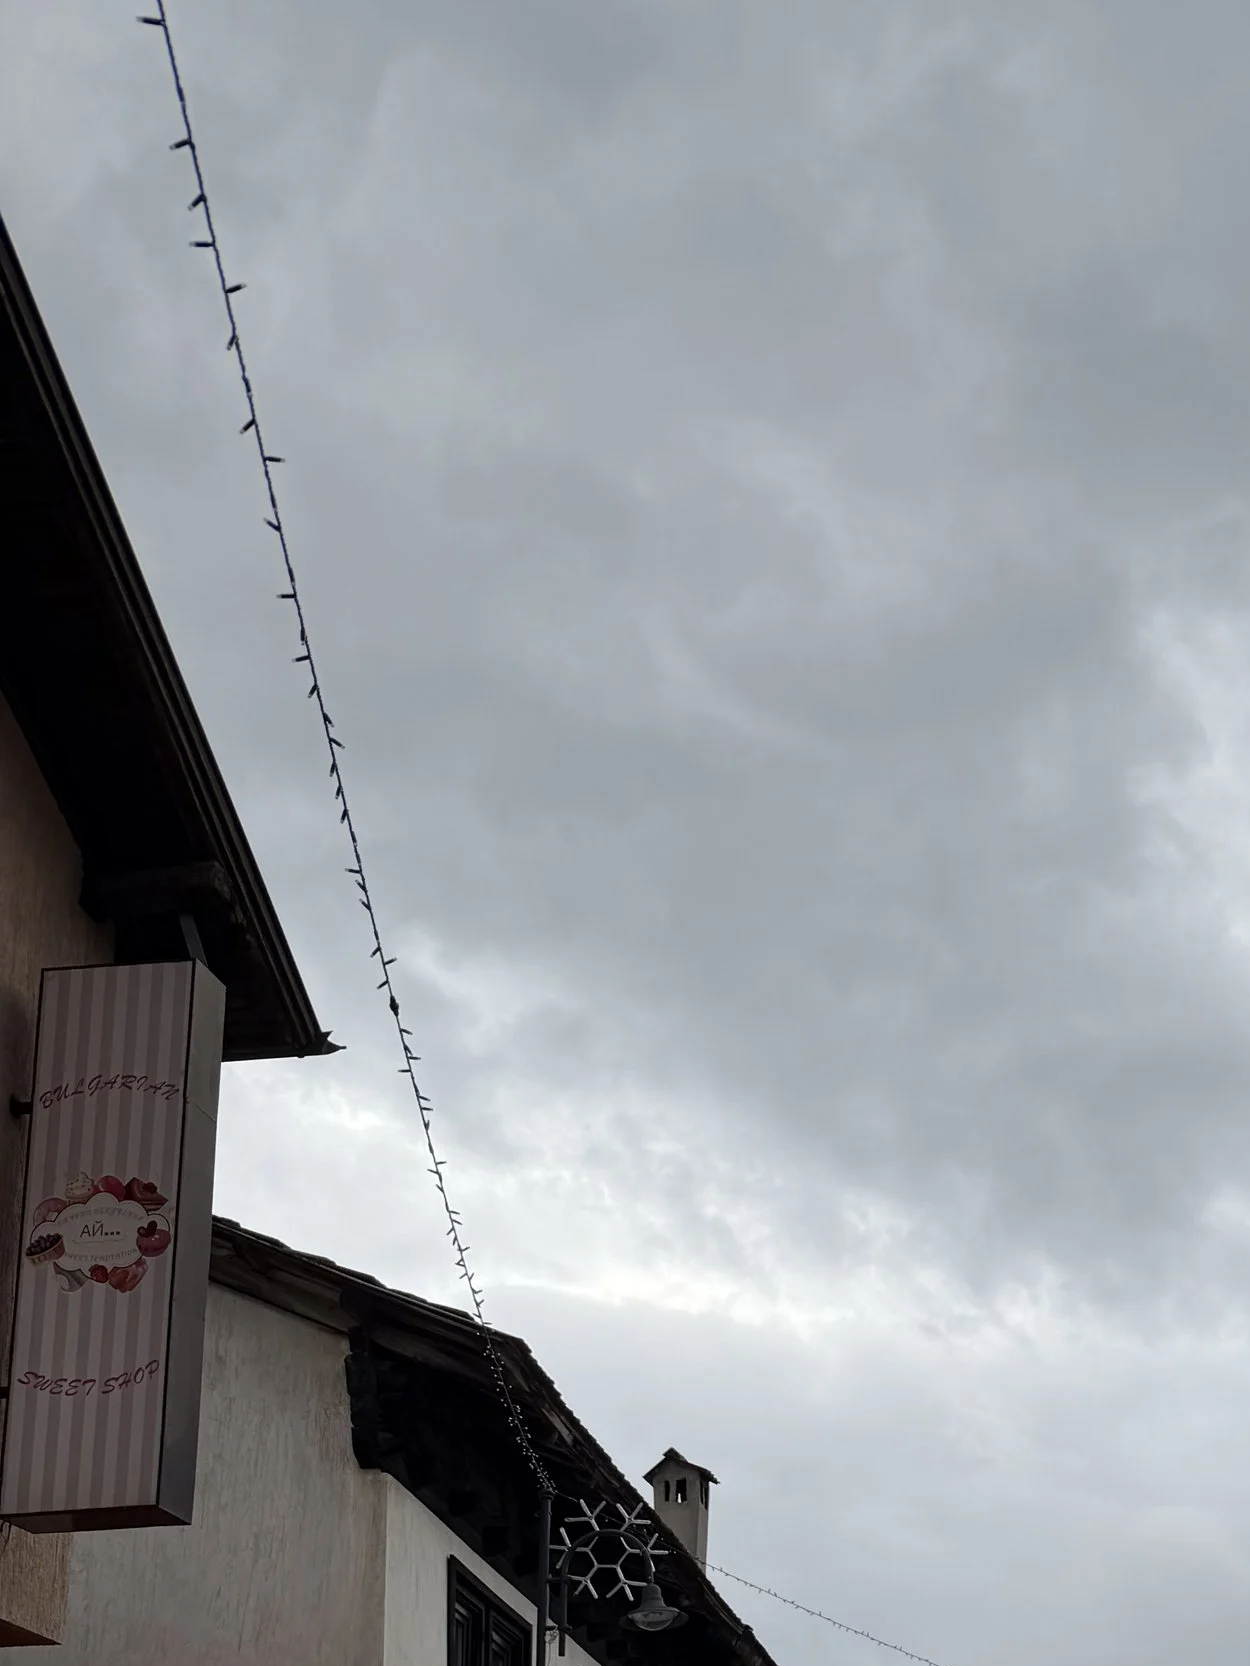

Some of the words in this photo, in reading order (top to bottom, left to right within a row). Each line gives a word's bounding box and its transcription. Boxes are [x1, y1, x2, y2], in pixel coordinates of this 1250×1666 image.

[39, 1073, 180, 1110] BULGARIAN
[16, 1371, 97, 1397] SWEET
[102, 1359, 160, 1395] SHOP
